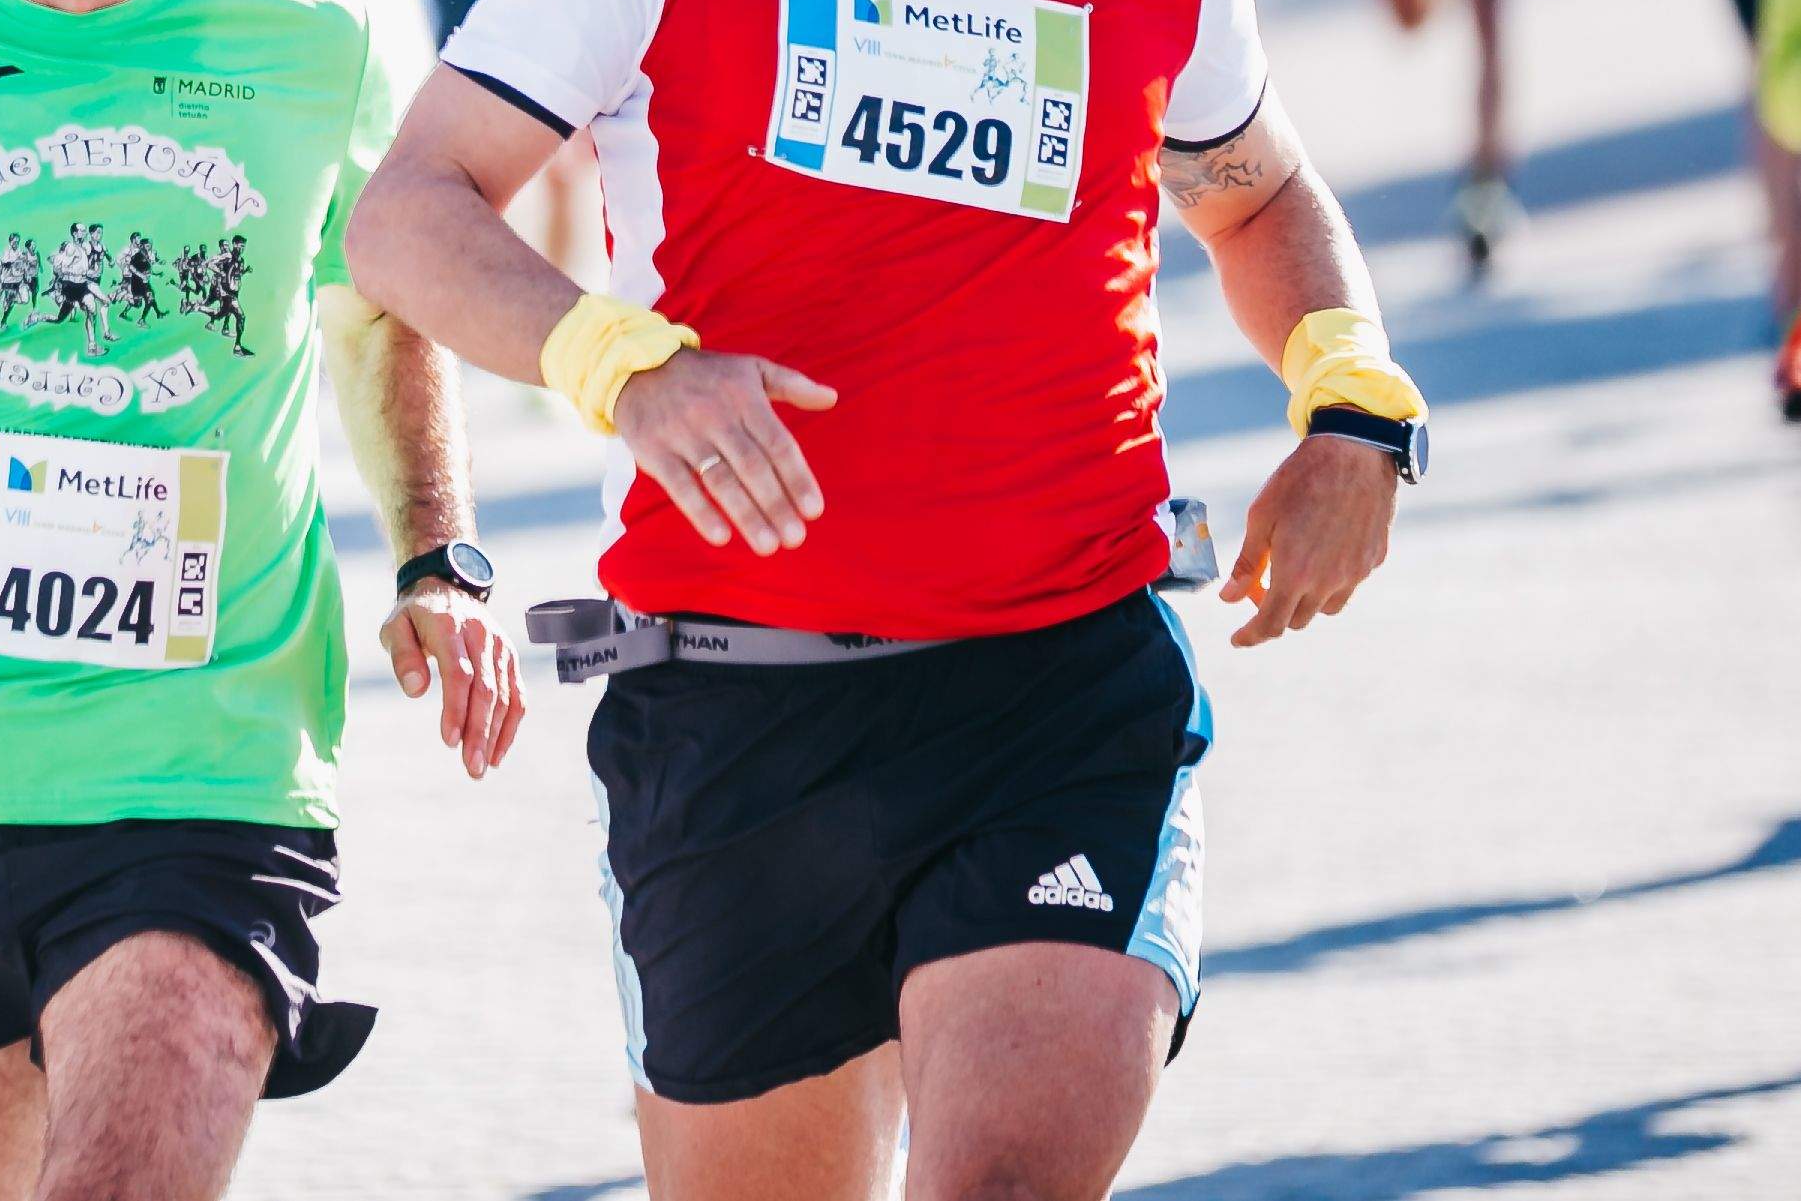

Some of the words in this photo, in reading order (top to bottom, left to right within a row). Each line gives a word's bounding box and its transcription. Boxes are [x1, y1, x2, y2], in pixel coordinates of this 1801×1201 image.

[905, 3, 1023, 44] MetLife
[853, 36, 881, 57] VIII
[178, 79, 256, 100] MADRID
[841, 94, 1013, 187] 4529
[144, 359, 199, 404] IX
[57, 467, 168, 501] MetLife
[5, 507, 32, 528] VIII
[1027, 884, 1114, 912] adidas
